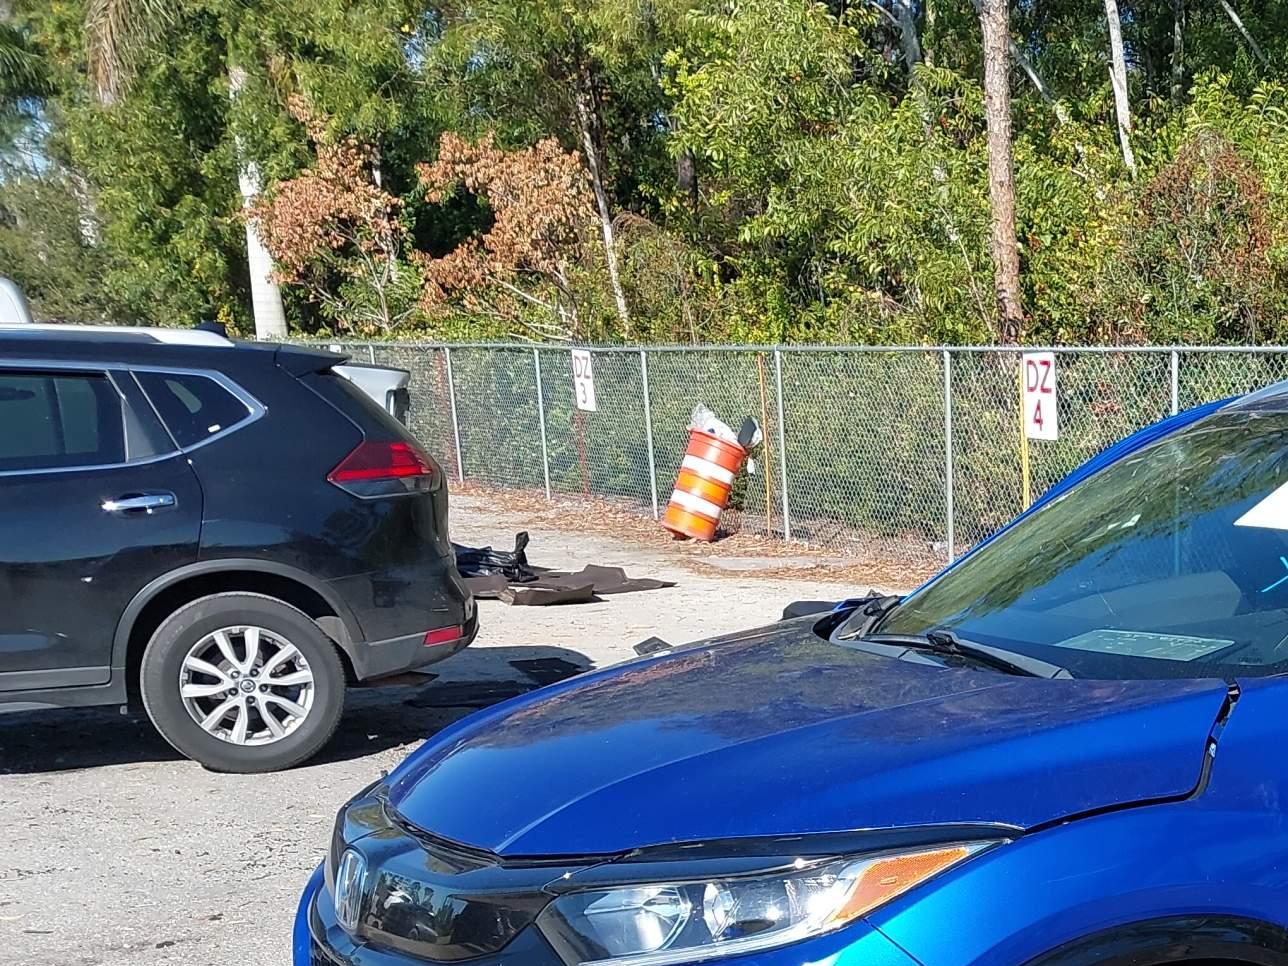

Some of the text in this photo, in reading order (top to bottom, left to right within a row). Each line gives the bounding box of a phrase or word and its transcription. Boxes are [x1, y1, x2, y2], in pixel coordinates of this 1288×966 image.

[574, 354, 591, 380] DZ
[1026, 359, 1052, 394] DZ
[580, 382, 588, 404] 3
[1033, 399, 1043, 432] 4
